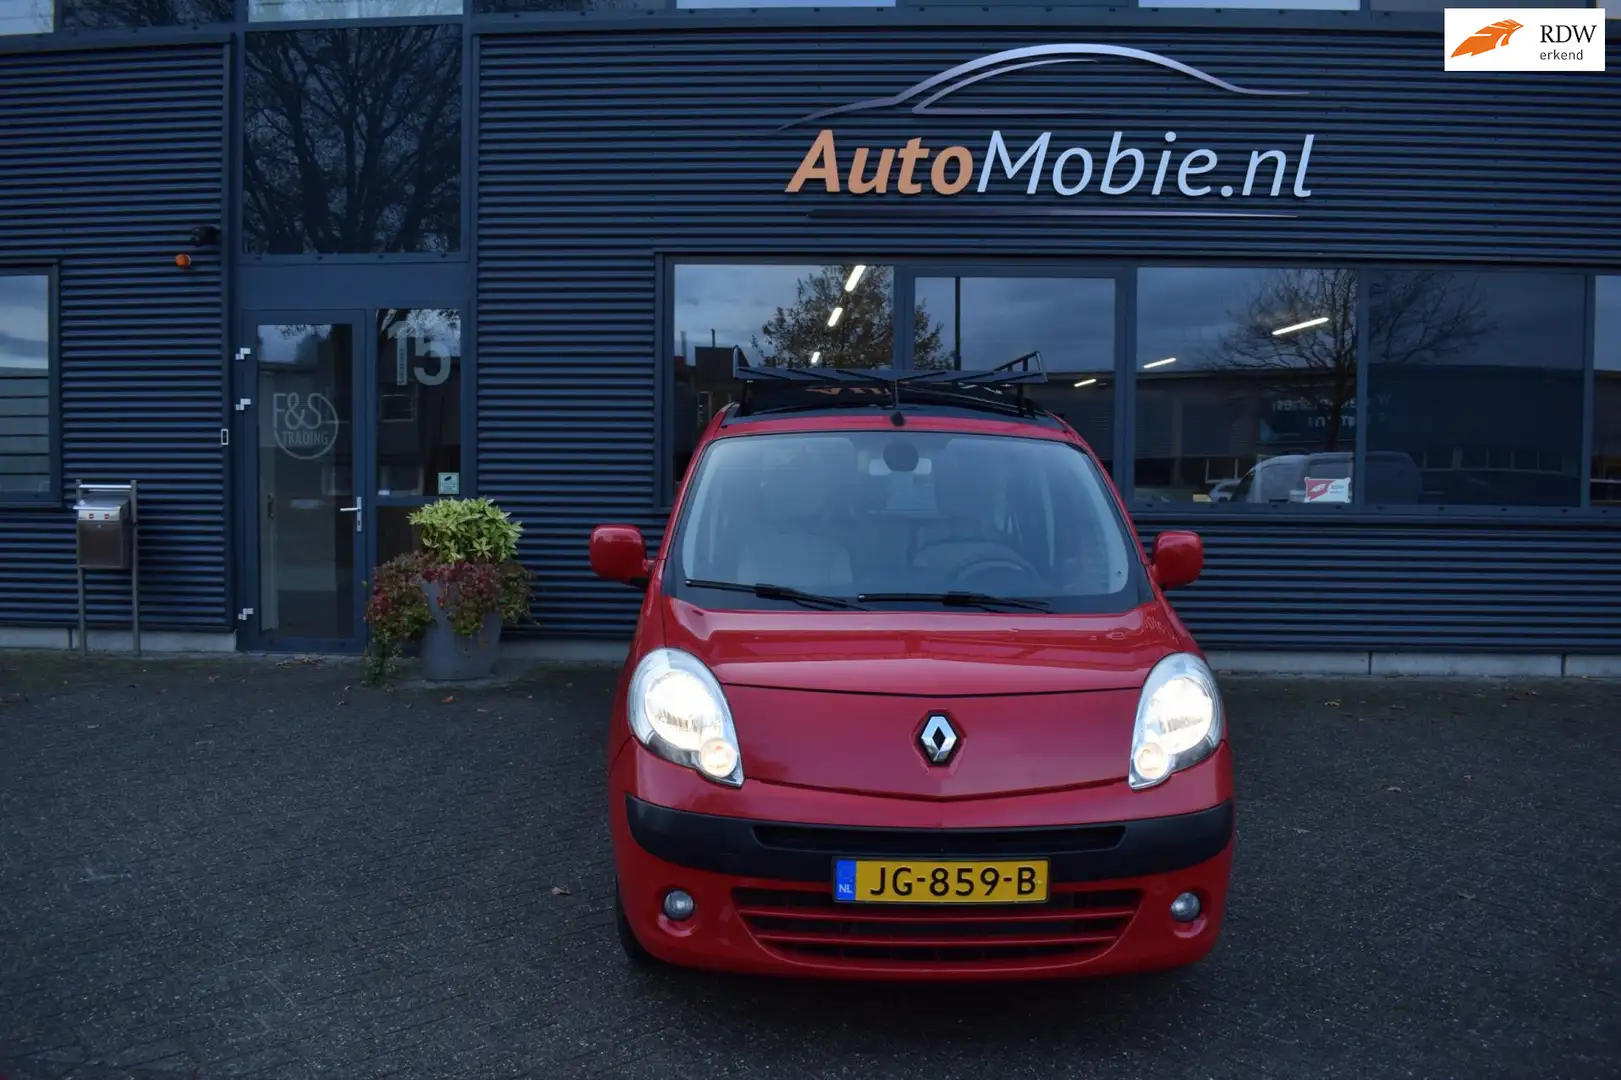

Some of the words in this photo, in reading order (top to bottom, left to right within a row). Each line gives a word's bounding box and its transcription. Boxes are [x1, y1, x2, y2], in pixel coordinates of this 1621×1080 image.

[785, 129, 1315, 198] AutoMobie.nl
[387, 320, 450, 386] 15
[273, 392, 322, 430] F&S
[282, 431, 328, 446] TRADING
[838, 884, 854, 894] NL
[870, 867, 1036, 897] JG-859-B
